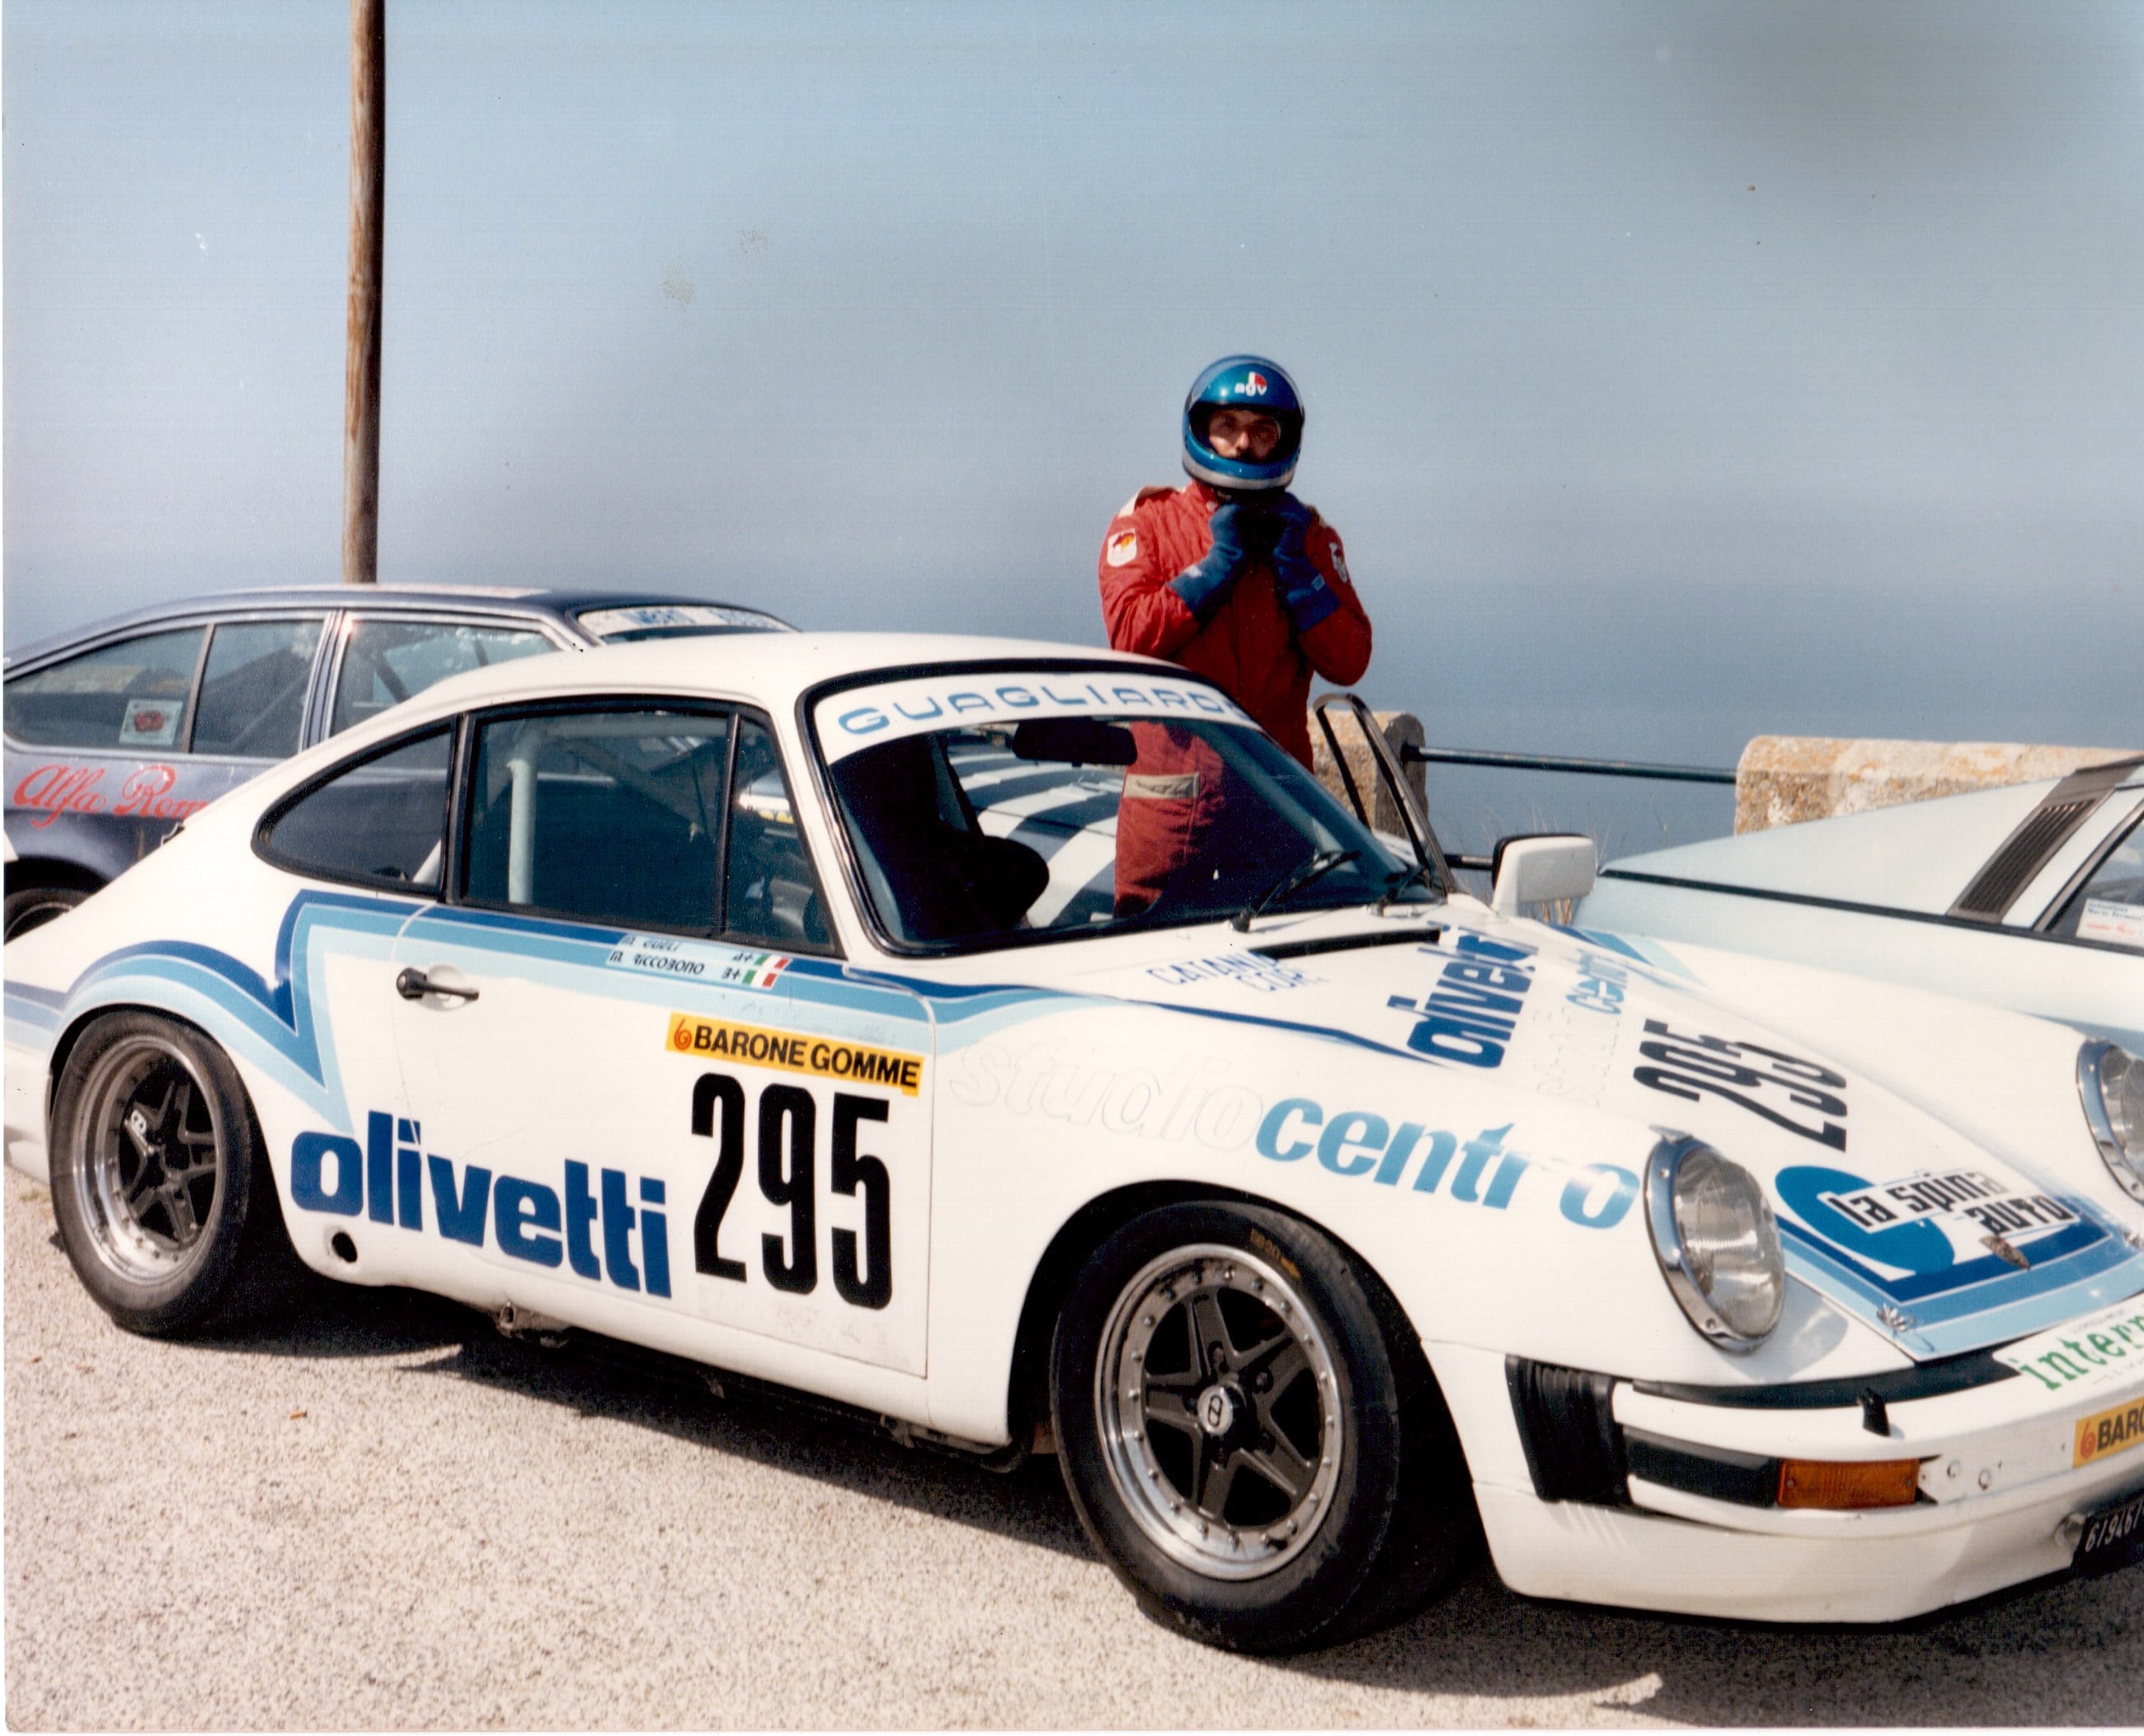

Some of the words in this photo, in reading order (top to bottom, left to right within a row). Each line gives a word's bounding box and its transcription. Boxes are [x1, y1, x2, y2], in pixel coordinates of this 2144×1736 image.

[12, 764, 107, 829] Alfa
[633, 953, 706, 976] RICCOBONO
[694, 1024, 808, 1066] BARONE
[810, 1043, 920, 1089] GOMME
[1634, 1019, 1847, 1152] 295
[290, 1108, 672, 1299] olivetti
[690, 1071, 893, 1310] 295
[1827, 1195, 1899, 1228] la
[1964, 1195, 2076, 1235] auto
